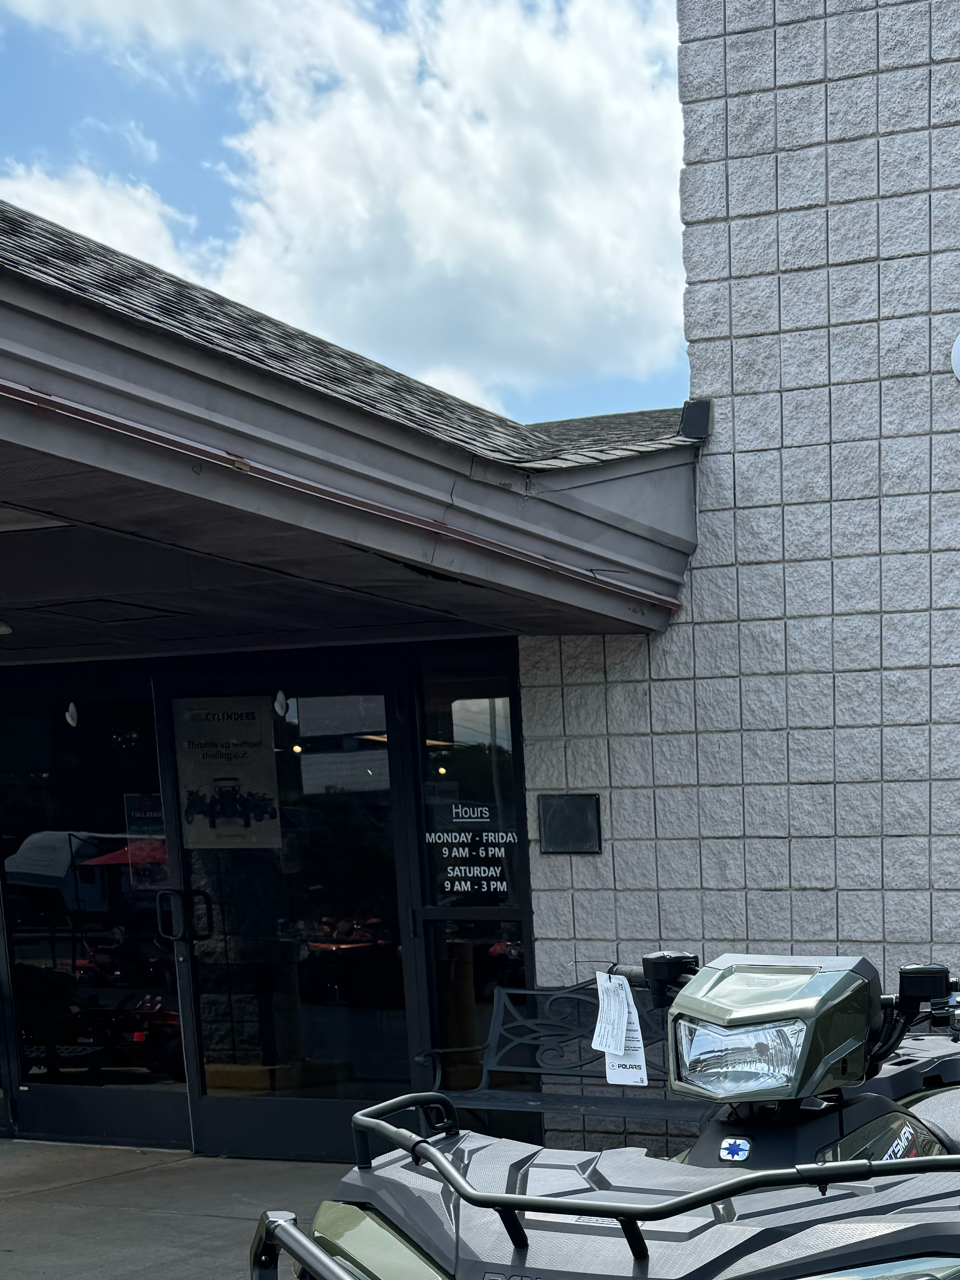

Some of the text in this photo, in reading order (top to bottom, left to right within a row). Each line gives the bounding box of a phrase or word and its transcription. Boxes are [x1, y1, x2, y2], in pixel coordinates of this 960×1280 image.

[452, 804, 490, 818] Hours
[425, 832, 472, 843] MONDAY
[442, 846, 449, 858] 9
[451, 846, 469, 858] AM
[479, 846, 486, 858] 6
[488, 847, 505, 858] PM
[447, 866, 502, 878] SATURDAY
[444, 880, 451, 892] 9
[453, 881, 471, 892] AM
[481, 881, 488, 892] 3
[490, 881, 507, 892] PM
[617, 1063, 642, 1071] POLARIS
